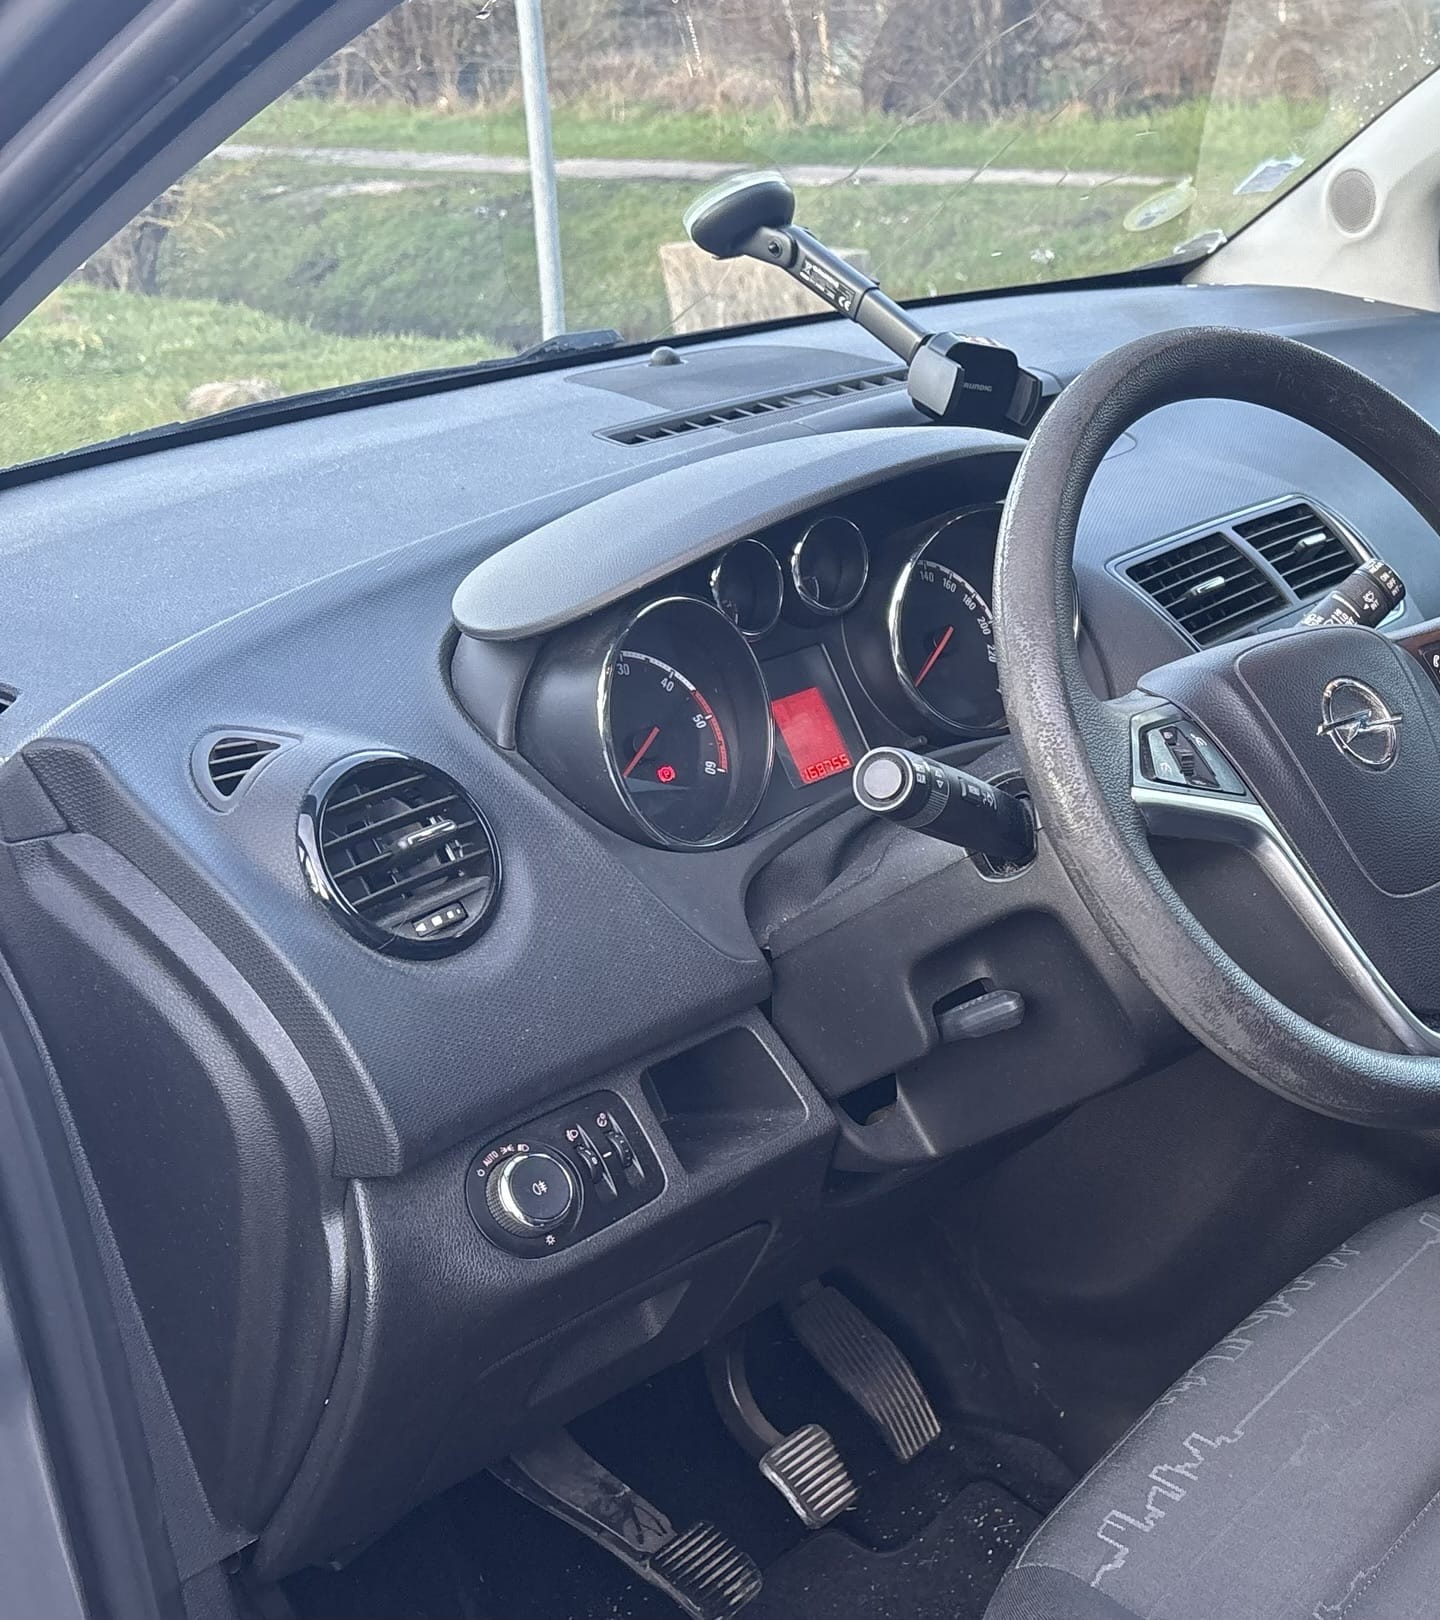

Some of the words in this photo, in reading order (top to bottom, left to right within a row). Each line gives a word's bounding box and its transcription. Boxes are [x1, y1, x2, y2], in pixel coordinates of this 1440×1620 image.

[963, 382, 993, 392] RUNDIG
[919, 570, 935, 583] 140
[942, 577, 957, 593] 160
[961, 594, 977, 611] 180
[977, 616, 991, 635] 200
[616, 663, 630, 676] 30
[660, 678, 675, 693] 40
[692, 713, 707, 729] 50
[704, 760, 717, 776] 60
[803, 753, 850, 782] 168755
[482, 1150, 499, 1167] AUTO
